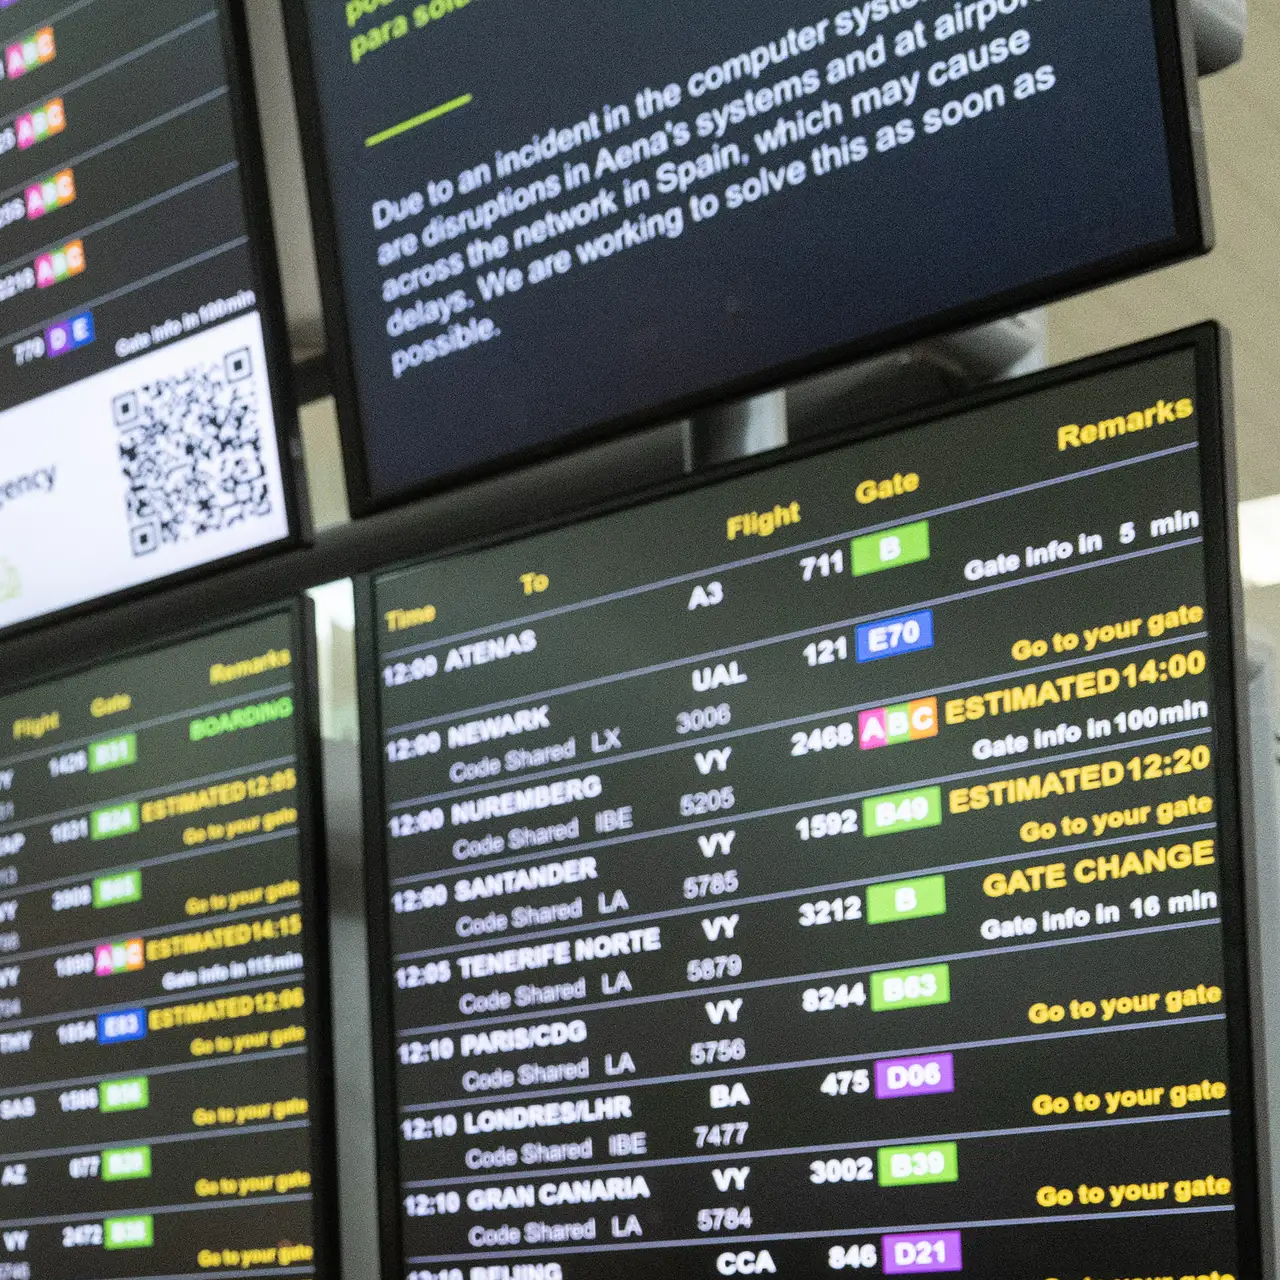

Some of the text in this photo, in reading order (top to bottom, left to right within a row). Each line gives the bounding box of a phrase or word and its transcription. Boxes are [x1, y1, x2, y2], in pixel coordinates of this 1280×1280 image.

[351, 15, 408, 64] para
[372, 191, 424, 229] Due
[427, 180, 453, 206] to
[458, 163, 491, 194] an
[495, 112, 600, 178] incident
[603, 103, 630, 133] in
[636, 83, 681, 119] the
[687, 18, 830, 97] computer
[377, 233, 418, 266] are
[422, 173, 561, 247] disruptions
[564, 162, 590, 190] in
[594, 121, 690, 179] Aena's
[696, 67, 820, 137] systems
[826, 34, 886, 84] and
[894, 20, 928, 57] at
[382, 28, 1031, 302] across the network in Spain, which may cause
[386, 64, 1056, 337] delays. We are working to solve this as soon as
[391, 317, 501, 378] possible.
[520, 572, 549, 596] To
[727, 501, 801, 541] Flight
[855, 472, 920, 505] Gate
[1057, 398, 1193, 451] Remarks
[964, 509, 1199, 581] Gate info in 5 min
[444, 536, 901, 672] ATENAS A3 711 B
[1011, 605, 1204, 661] Go to your gate
[447, 620, 920, 750] NEWARK UAL 121 E70
[450, 650, 1206, 825] NUREMBERG VY 2468 ESTIMATED 14:00
[454, 745, 1211, 902] SANTANDER VY 1592 B49 ESTIMATED 12:20
[983, 840, 1215, 897] GATE CHANGE
[457, 887, 917, 979] TENERIFE NORTE VY 3212 B
[460, 973, 937, 1057] PARIS/CDG VY 8244 B63
[464, 1062, 941, 1135] LONDRES/LHR BA 475 D06
[466, 1151, 945, 1212] GRAN CANARIA VY 3002 B39
[716, 1250, 777, 1276] CCA
[828, 1243, 877, 1270] 846
[894, 1240, 946, 1266] D21
